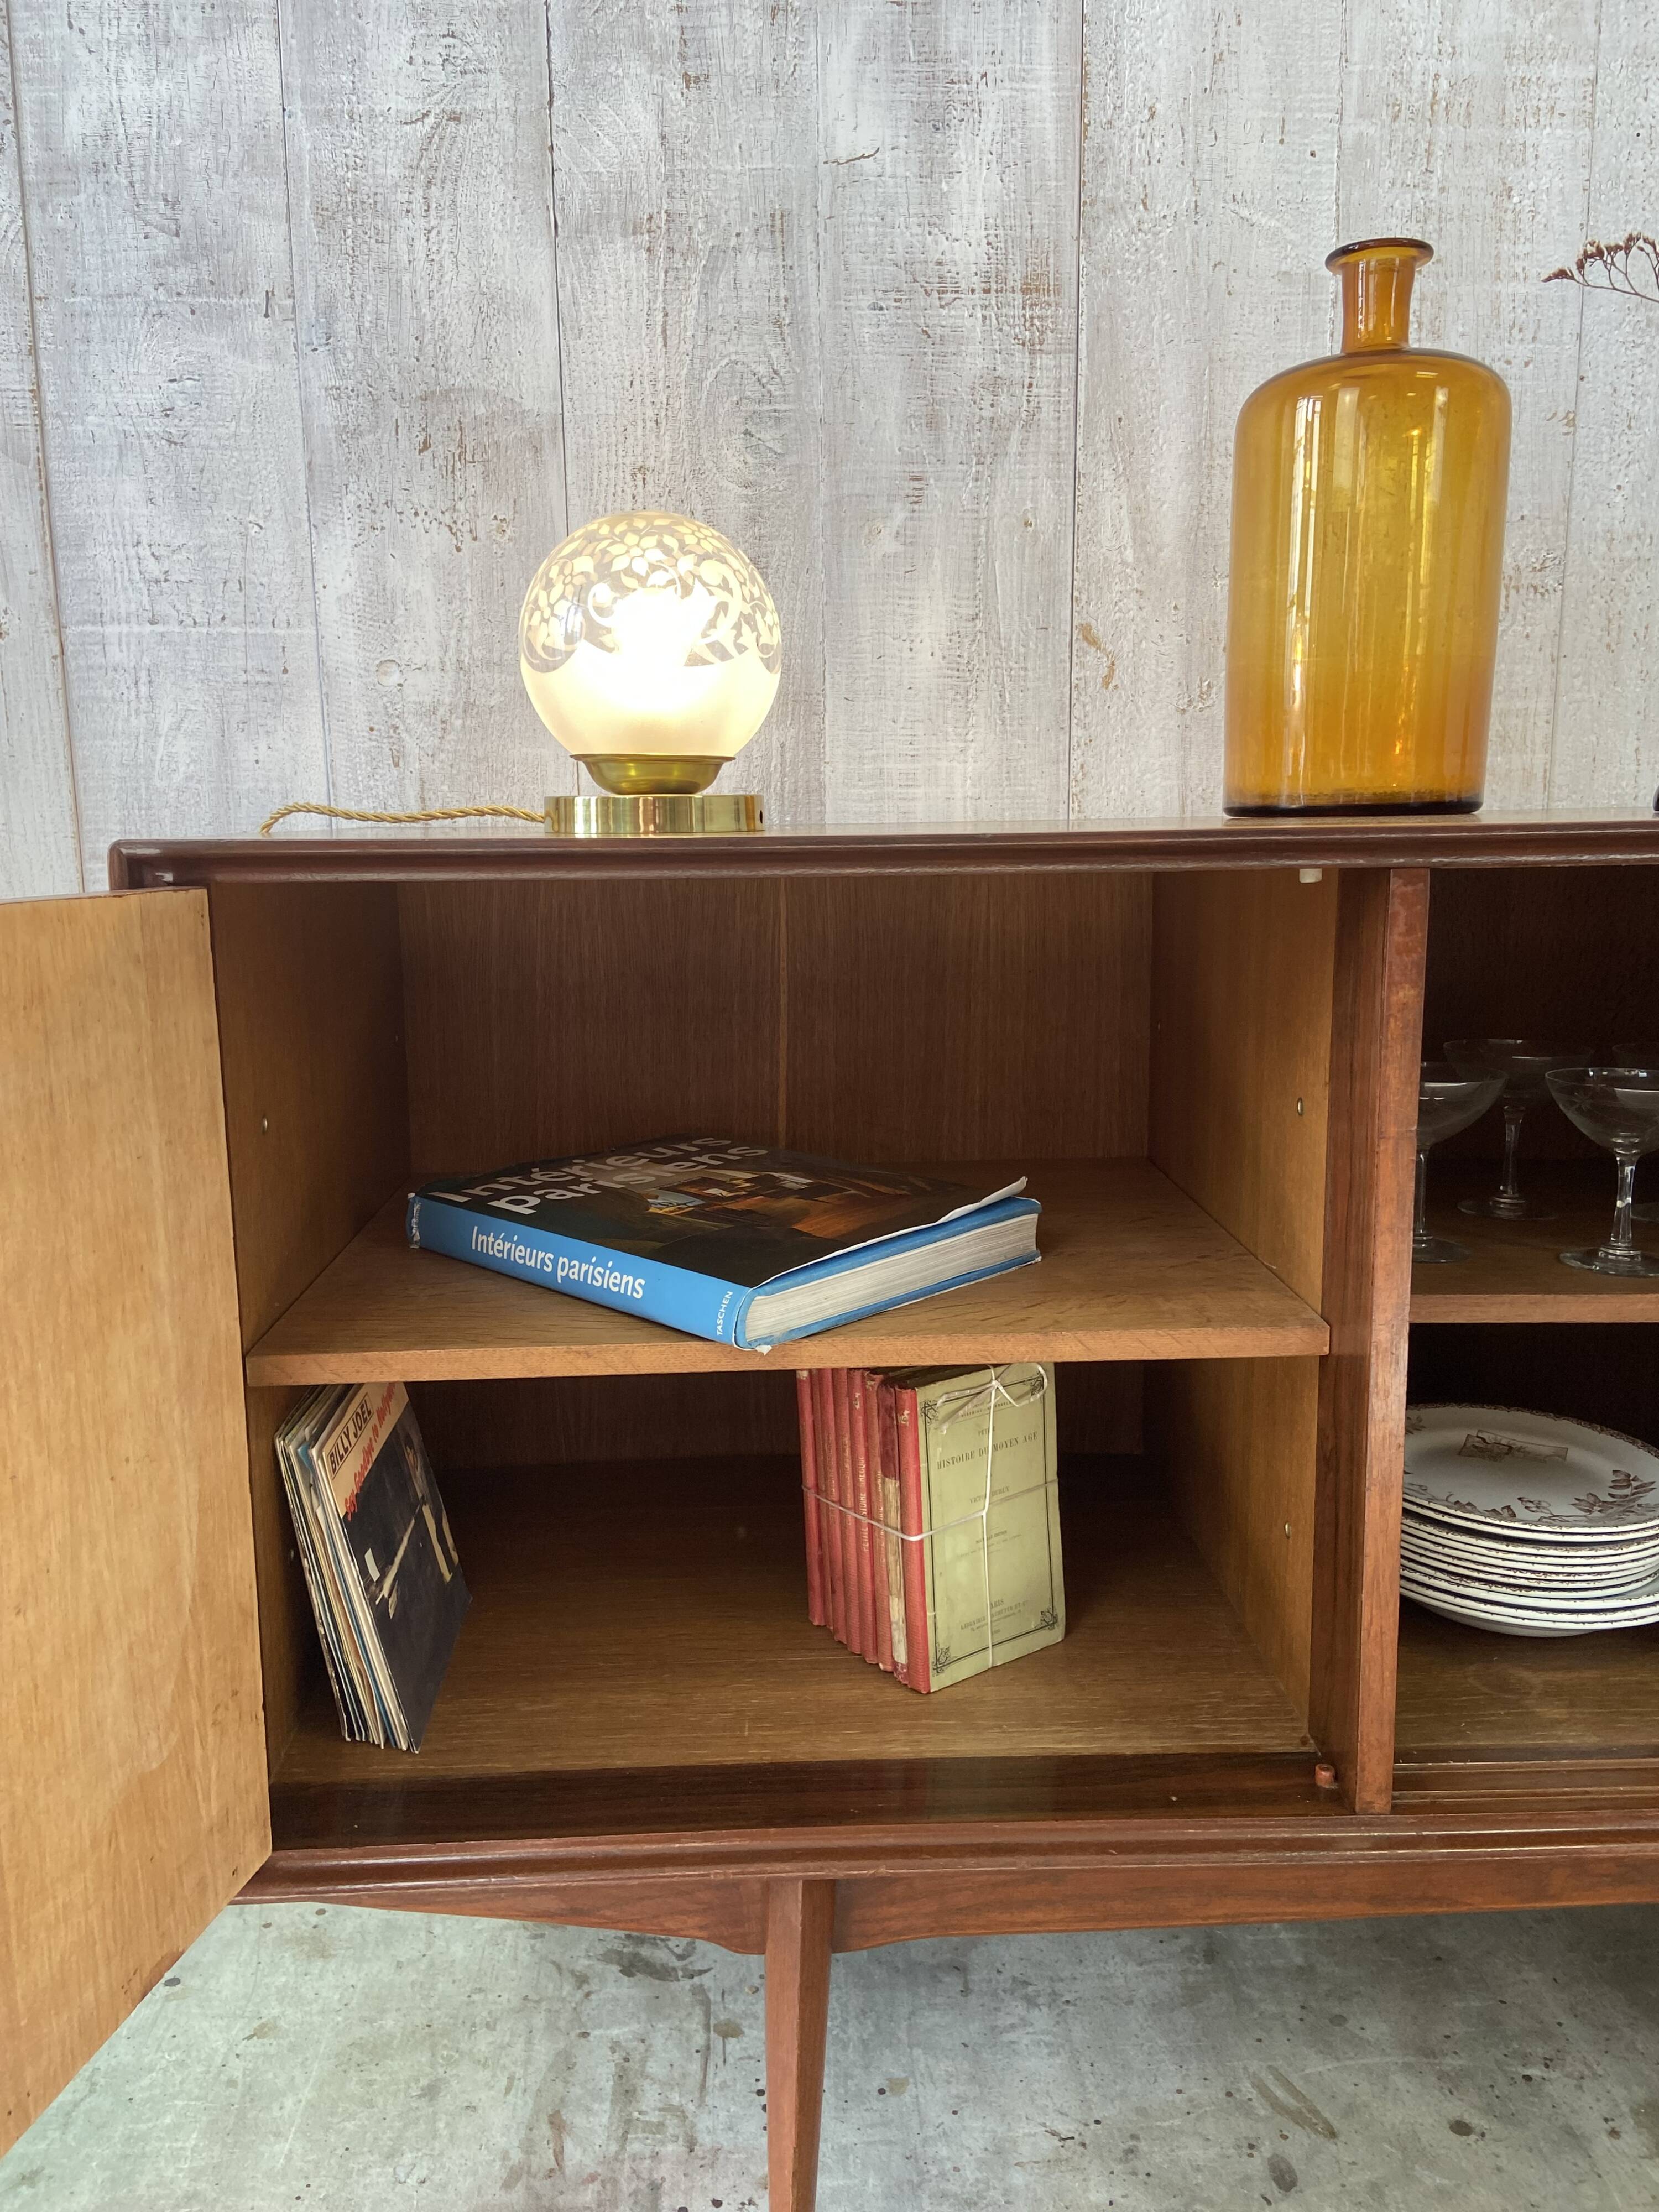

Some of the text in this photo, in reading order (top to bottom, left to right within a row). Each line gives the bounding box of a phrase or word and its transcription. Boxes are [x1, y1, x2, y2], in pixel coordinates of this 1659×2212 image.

[427, 1137, 731, 1203] Intérieurs
[487, 1145, 769, 1215] parisiens
[471, 1225, 645, 1300] Intérieurs parisiens
[716, 1290, 734, 1337] TASCHEN
[329, 1399, 373, 1475] BILLY JOEL
[372, 1423, 379, 1443] to
[937, 1450, 975, 1470] HISTOIRE
[993, 1436, 1020, 1453] MOYEN
[969, 1493, 988, 1504] VICTO
[989, 1598, 1005, 1610] ARIS
